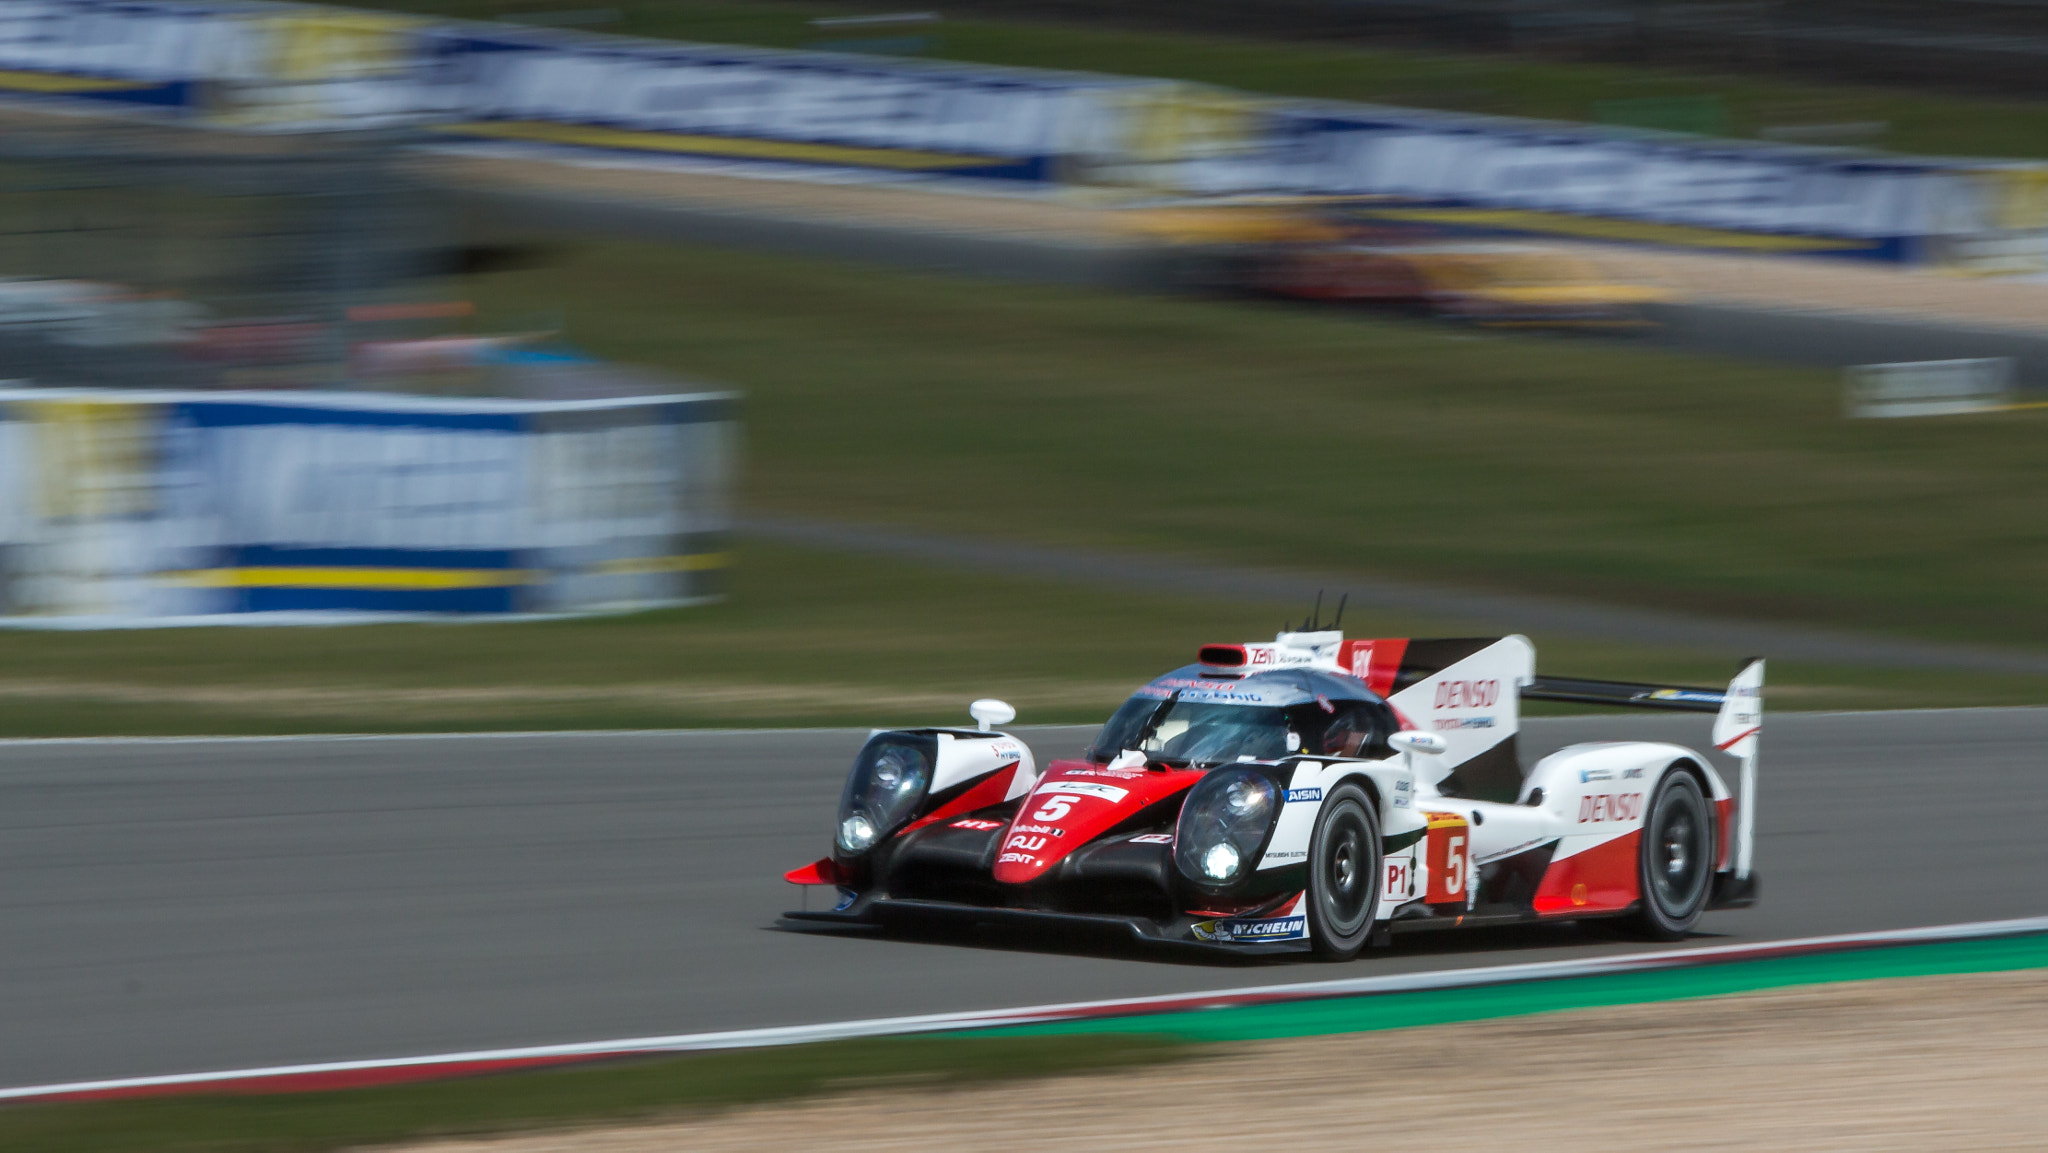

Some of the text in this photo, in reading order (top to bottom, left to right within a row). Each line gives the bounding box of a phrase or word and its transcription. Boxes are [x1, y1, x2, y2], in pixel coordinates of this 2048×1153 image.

[1434, 679, 1500, 710] DENSO
[1033, 795, 1082, 822] 5
[1289, 789, 1321, 801] AISIN
[1577, 792, 1643, 824] DENSO
[999, 852, 1035, 864] ZENT
[1445, 836, 1465, 895] 5
[1387, 864, 1407, 894] P1
[1233, 920, 1304, 934] MICHELIN
